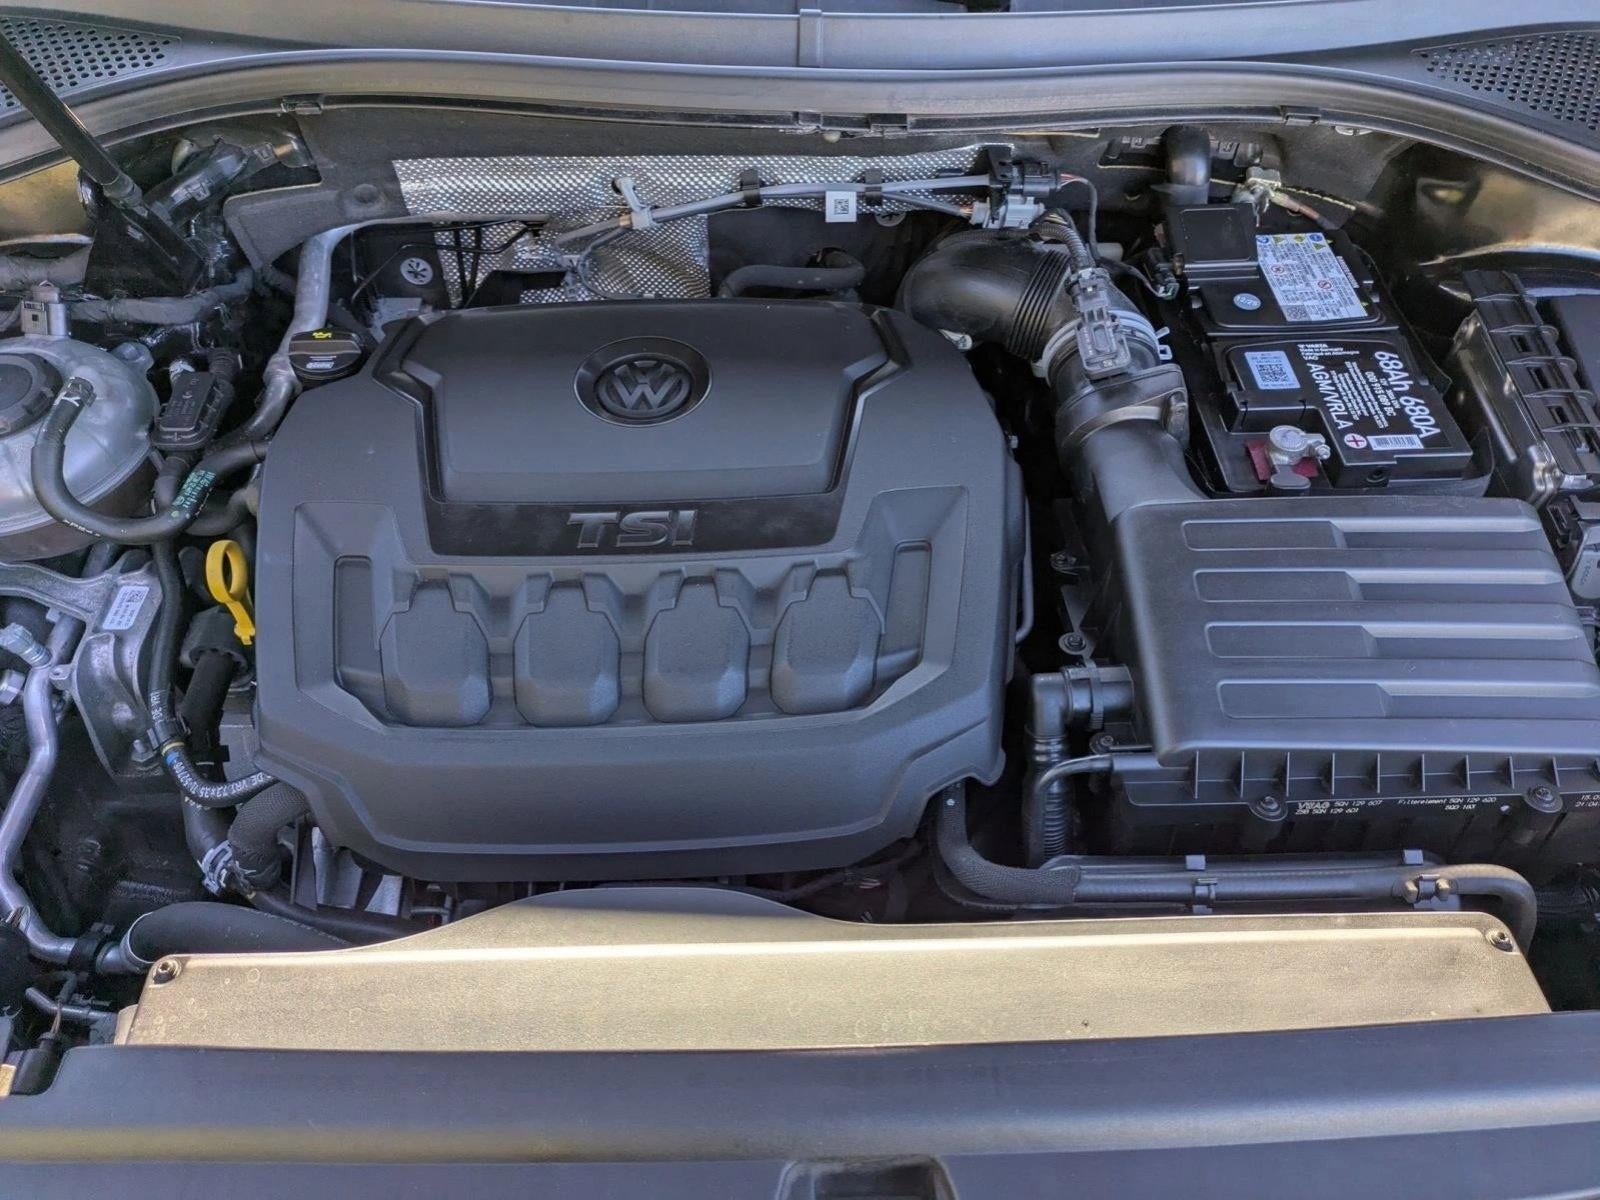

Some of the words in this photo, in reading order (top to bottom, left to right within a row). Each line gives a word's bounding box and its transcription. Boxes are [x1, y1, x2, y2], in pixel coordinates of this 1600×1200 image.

[1306, 362, 1354, 429] AGM/VRLA
[1374, 351, 1414, 391] 68Ah
[1399, 396, 1441, 438] 680A
[567, 509, 698, 549] TSI
